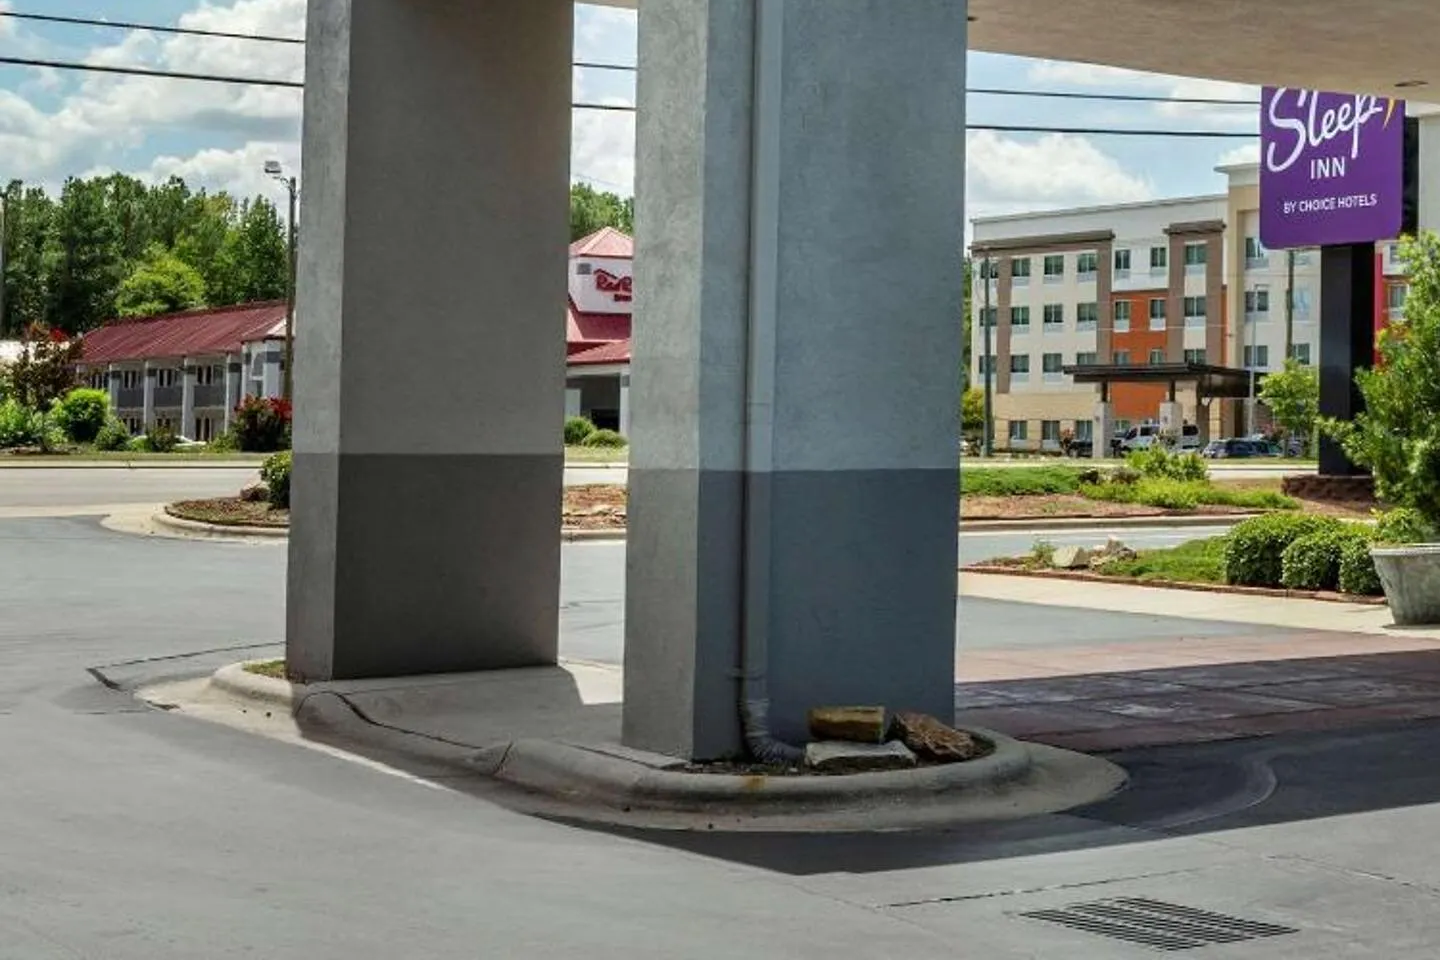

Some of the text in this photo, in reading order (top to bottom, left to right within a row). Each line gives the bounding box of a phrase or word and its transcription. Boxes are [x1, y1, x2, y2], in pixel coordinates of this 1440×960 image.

[1267, 88, 1383, 172] Sleep
[1310, 156, 1345, 179] INN
[1283, 193, 1378, 214] BY CHOICE HOTELS
